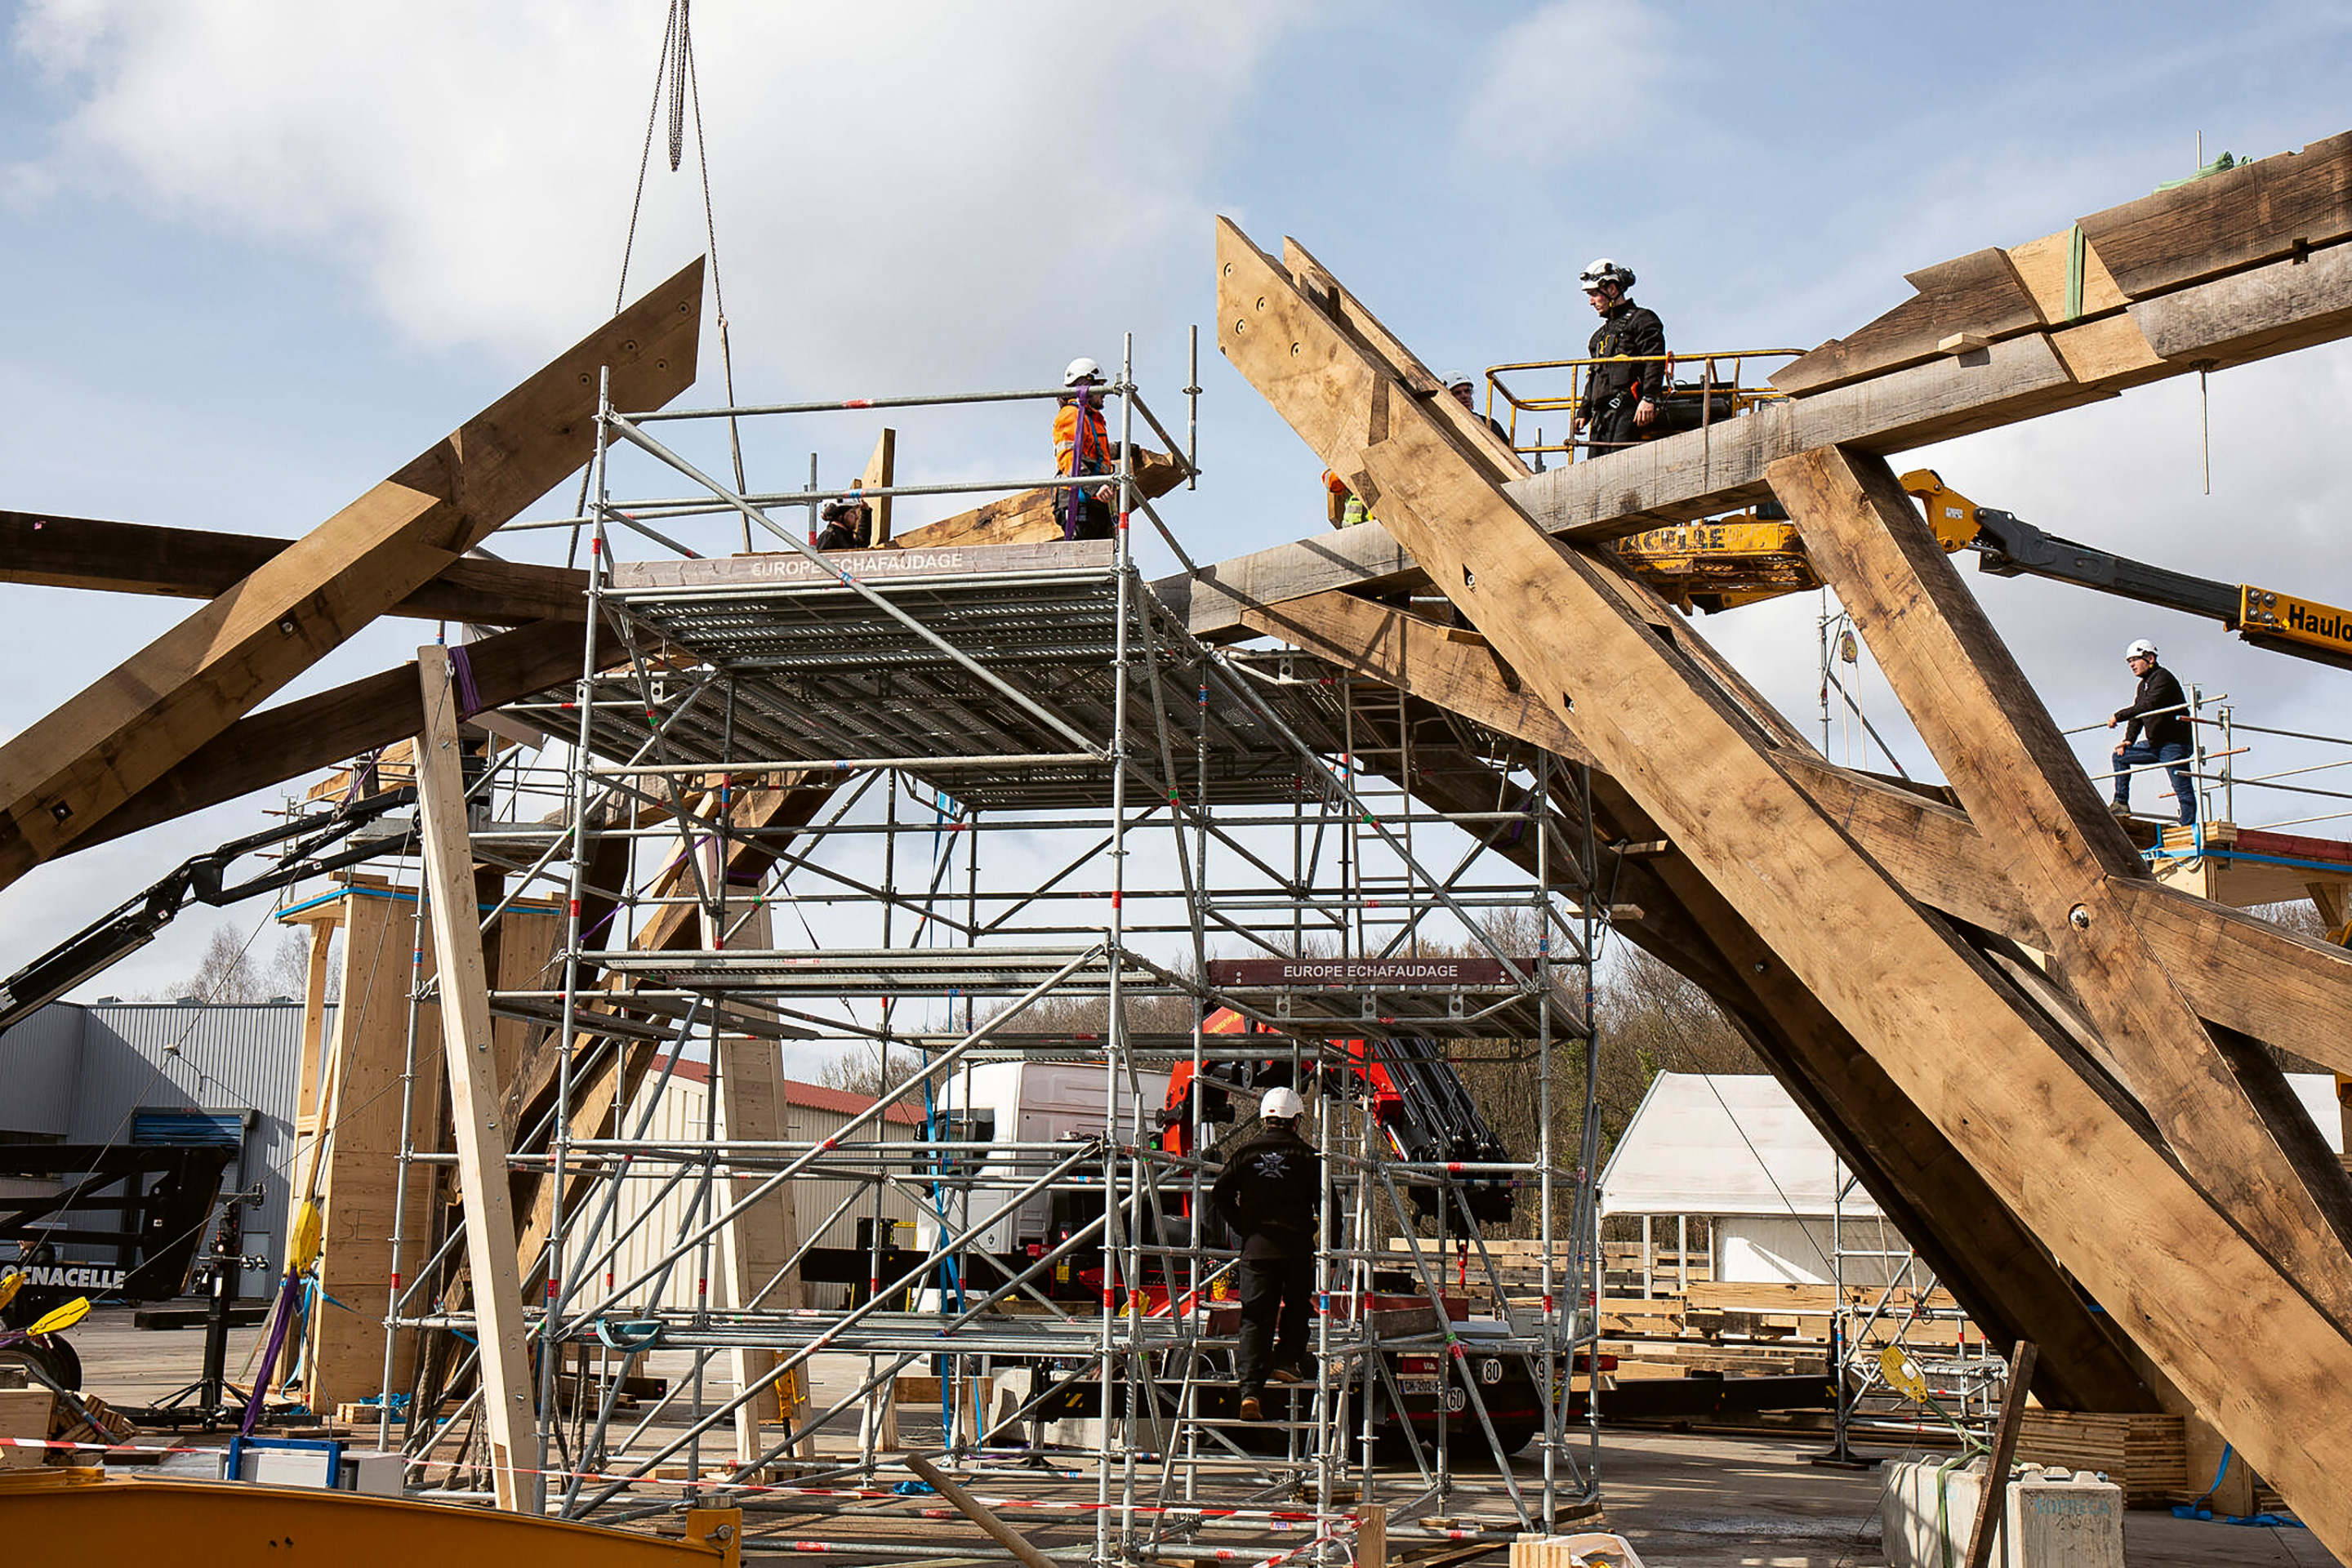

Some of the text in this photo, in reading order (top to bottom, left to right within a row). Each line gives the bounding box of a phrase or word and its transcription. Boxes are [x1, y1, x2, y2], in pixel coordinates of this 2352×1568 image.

[751, 559, 821, 577] EUROPE
[2289, 603, 2352, 643] Haulo
[1283, 965, 1459, 978] EUROPE ECHAFAUDAGE
[1486, 1361, 1500, 1382] 80
[1449, 1388, 1464, 1410] 60
